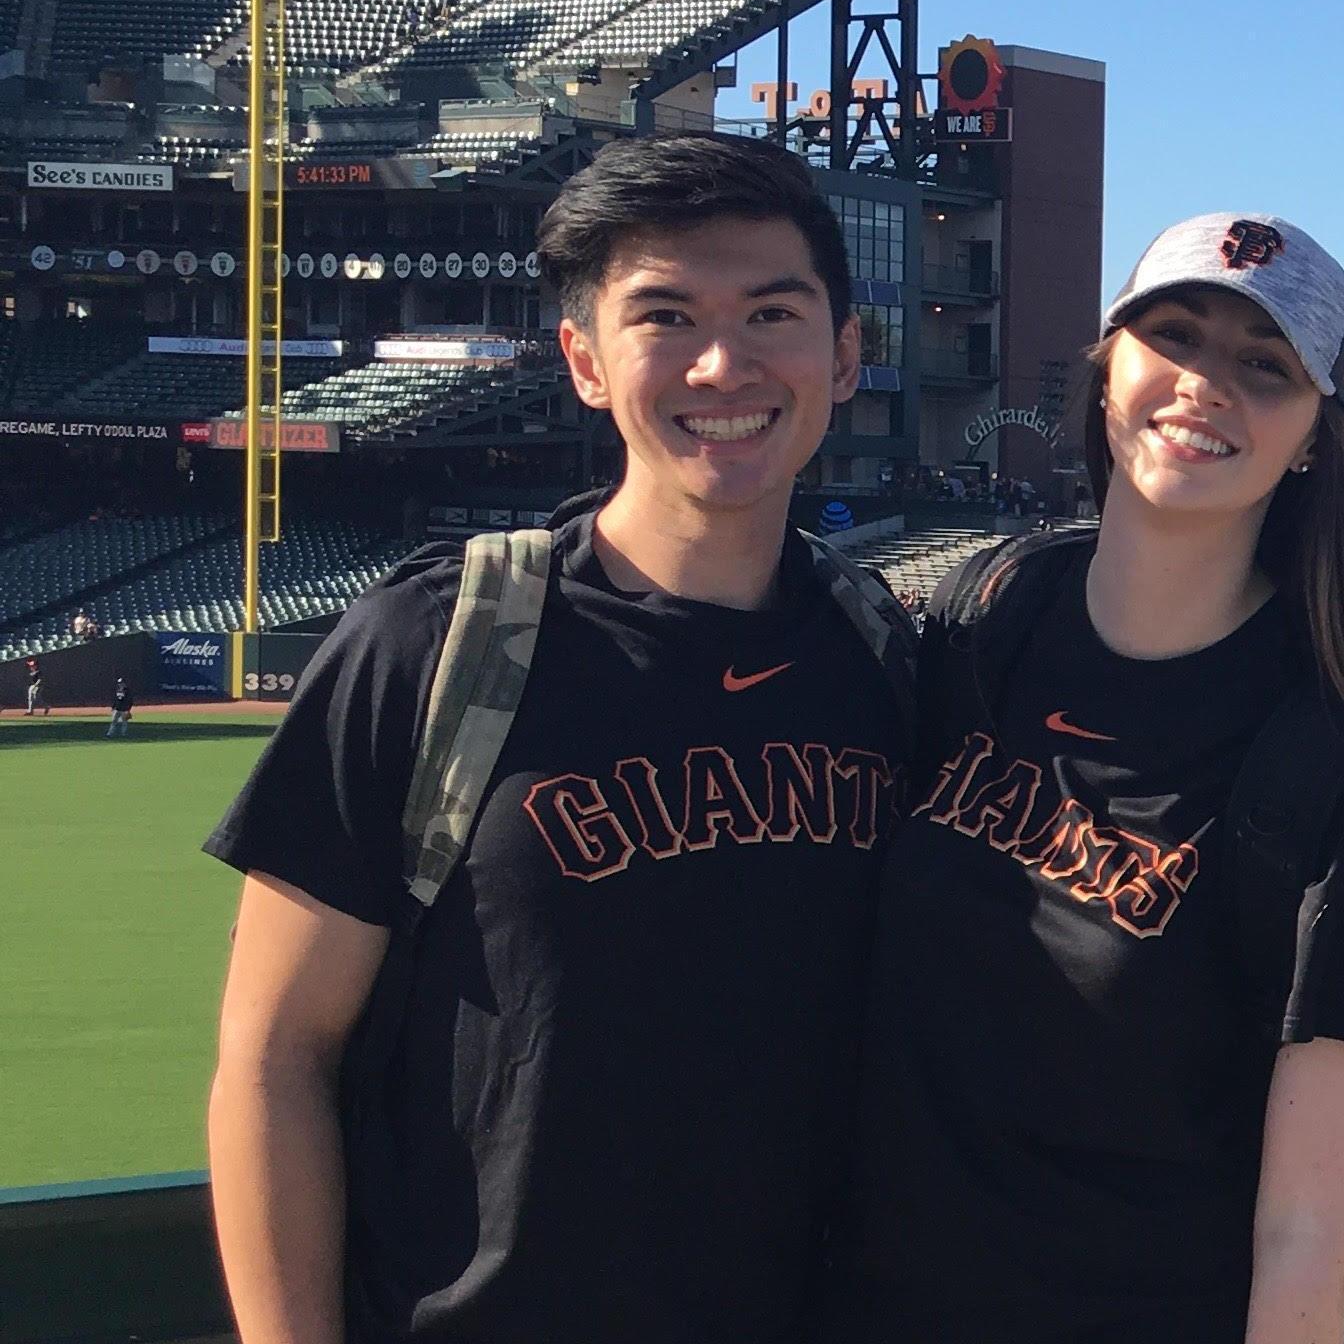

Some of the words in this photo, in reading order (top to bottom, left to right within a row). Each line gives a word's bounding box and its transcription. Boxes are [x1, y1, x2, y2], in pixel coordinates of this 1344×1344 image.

[947, 117, 962, 133] WE
[963, 118, 981, 133] ARE
[33, 165, 86, 185] See's
[92, 172, 164, 187] CANDIES
[297, 166, 346, 183] 5:41:33
[349, 165, 370, 182] PM
[62, 424, 102, 436] LEFTY
[137, 426, 167, 438] PLAZA
[245, 673, 294, 690] 339
[912, 732, 1199, 939] IANTS
